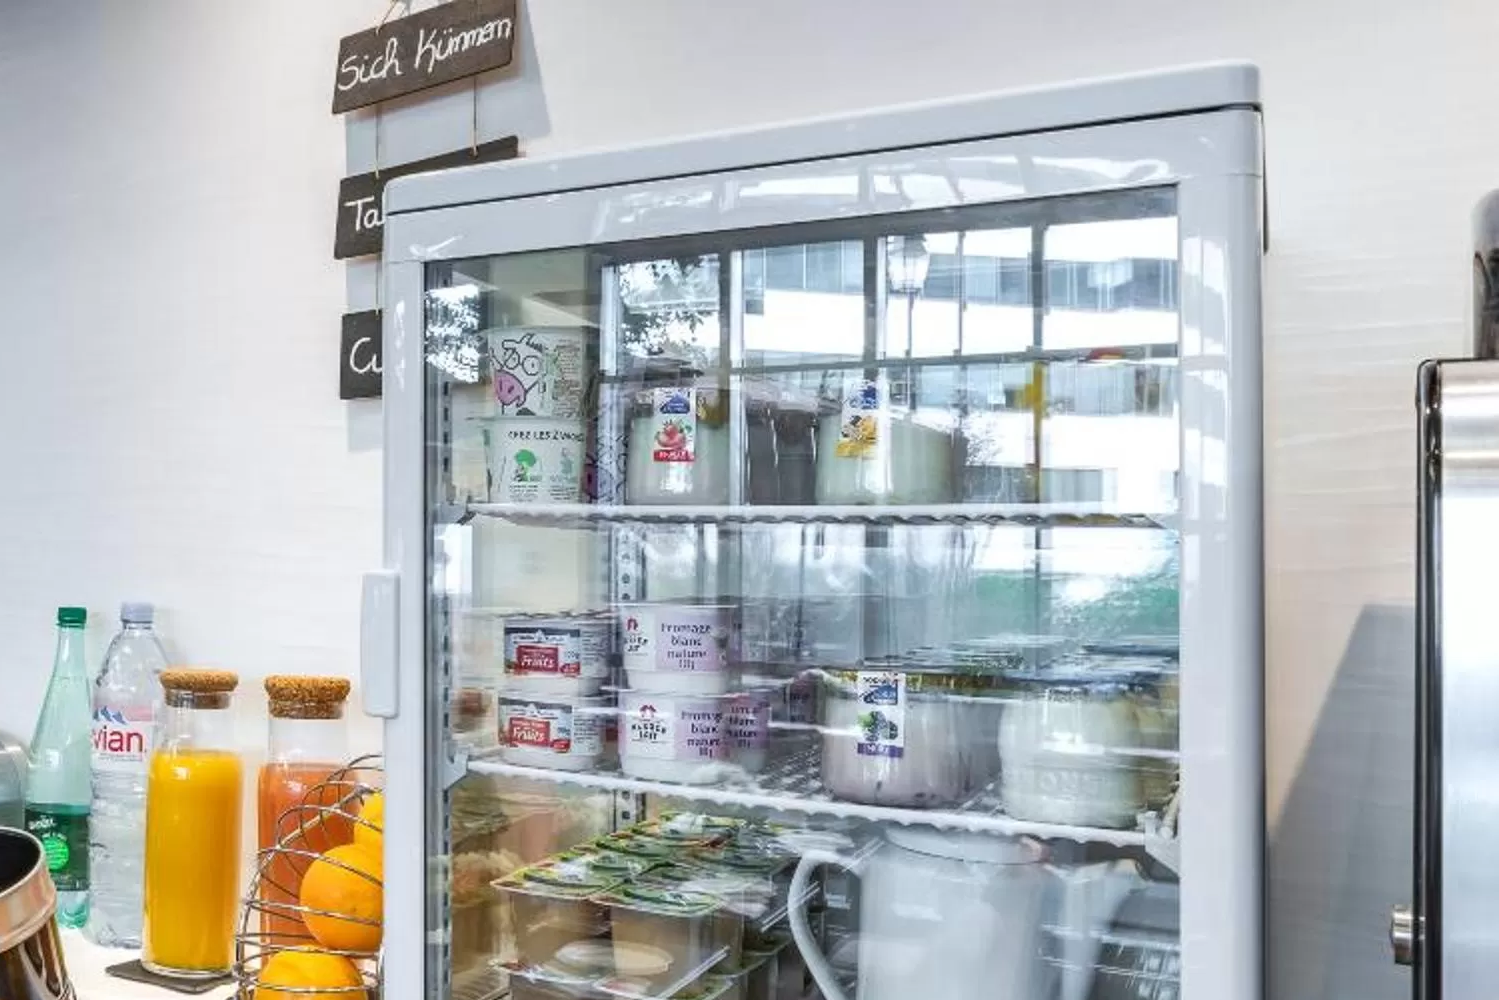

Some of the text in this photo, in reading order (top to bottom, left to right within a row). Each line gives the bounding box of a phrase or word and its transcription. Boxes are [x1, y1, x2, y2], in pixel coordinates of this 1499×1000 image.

[337, 37, 401, 91] Sich
[344, 195, 383, 231] Ta
[349, 337, 383, 374] Cu
[92, 724, 143, 753] vian
